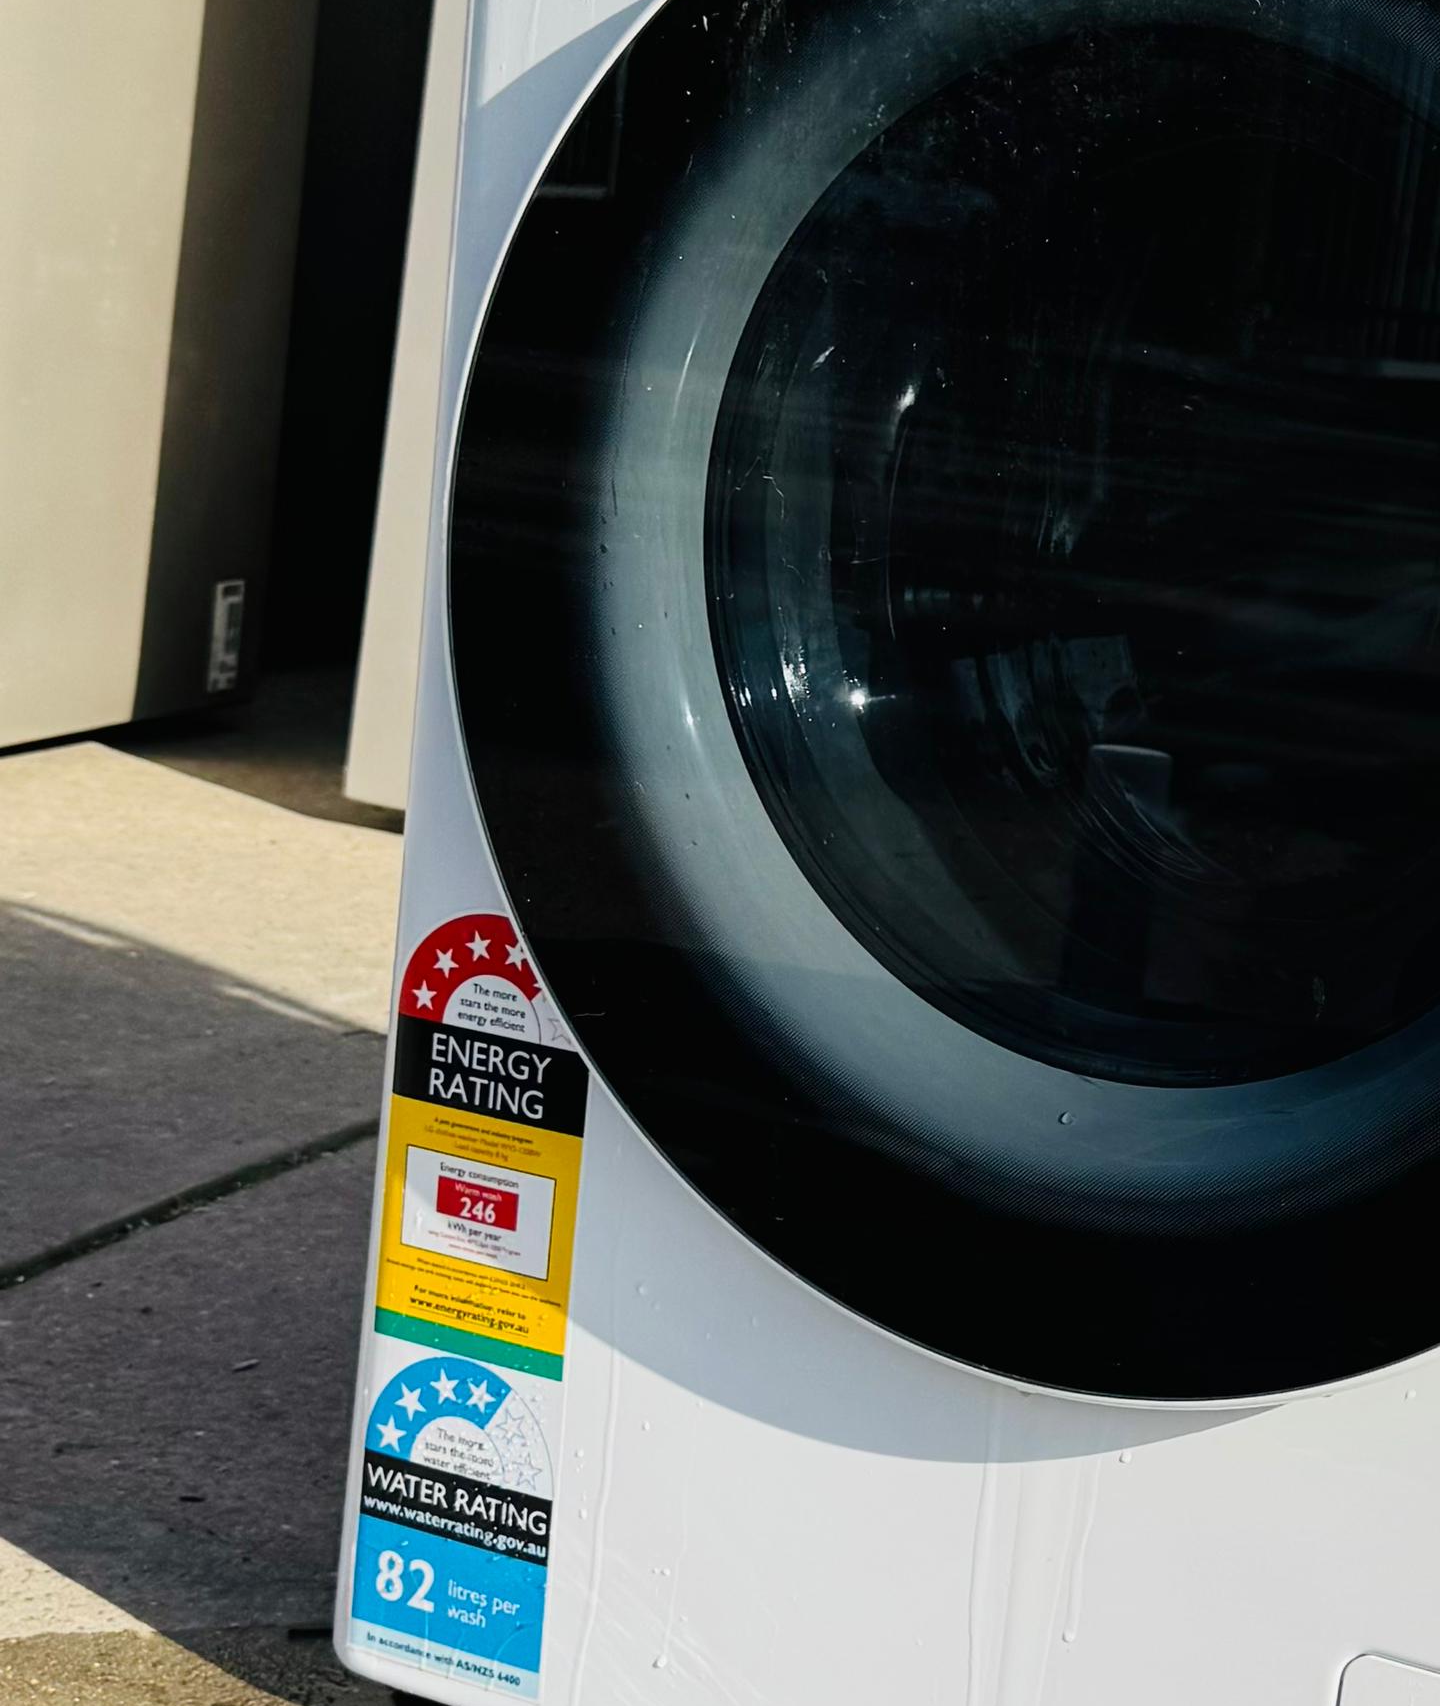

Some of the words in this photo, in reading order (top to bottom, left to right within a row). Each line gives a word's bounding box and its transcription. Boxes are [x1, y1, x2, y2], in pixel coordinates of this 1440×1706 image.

[473, 982, 490, 997] The
[492, 990, 518, 1002] more
[460, 998, 481, 1010] stars
[484, 1002, 499, 1013] the
[501, 1006, 526, 1019] more
[458, 1012, 487, 1027] energy
[490, 1017, 525, 1033] efficient
[430, 1032, 552, 1085] ENERGY
[429, 1067, 544, 1120] RATING
[440, 1161, 466, 1178] Energy
[468, 1171, 520, 1189] consumption
[454, 1182, 481, 1198] Warm
[482, 1189, 503, 1203] wash
[459, 1196, 496, 1224] 246
[447, 1220, 467, 1233] kWh
[468, 1225, 482, 1238] per
[484, 1231, 503, 1242] year
[437, 1427, 455, 1443] The
[423, 1456, 450, 1468] water
[366, 1462, 449, 1510] WATER
[453, 1488, 548, 1536] RATING
[363, 1495, 547, 1559] www.waterrating.gov.au
[375, 1549, 436, 1614] 82
[447, 1579, 489, 1611] litres
[492, 1596, 520, 1617] per
[447, 1605, 486, 1629] wash
[379, 1637, 432, 1660] accordane
